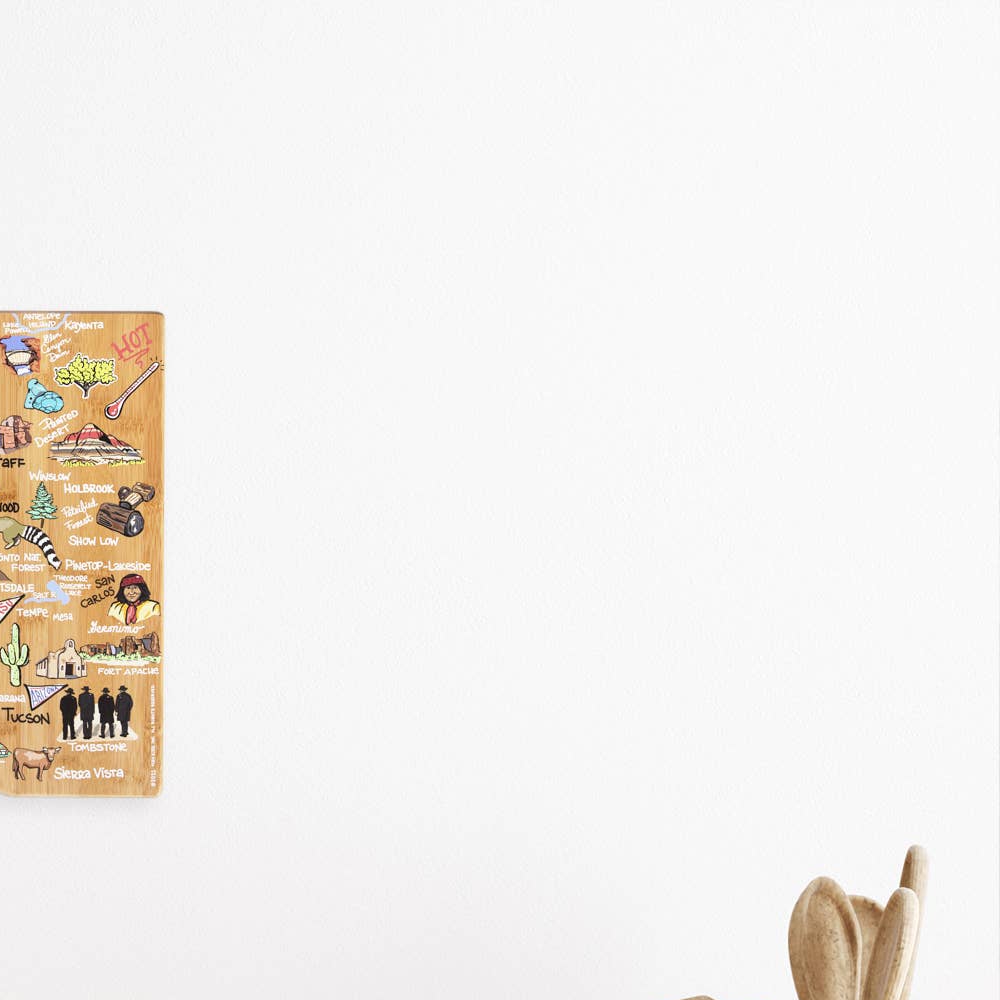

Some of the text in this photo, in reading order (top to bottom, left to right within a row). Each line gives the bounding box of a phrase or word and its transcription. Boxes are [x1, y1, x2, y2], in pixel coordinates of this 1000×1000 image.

[111, 322, 153, 360] HOT
[63, 483, 115, 493] HOLBROOK
[88, 620, 146, 634] Geronimo
[30, 686, 58, 706] ARIZONA
